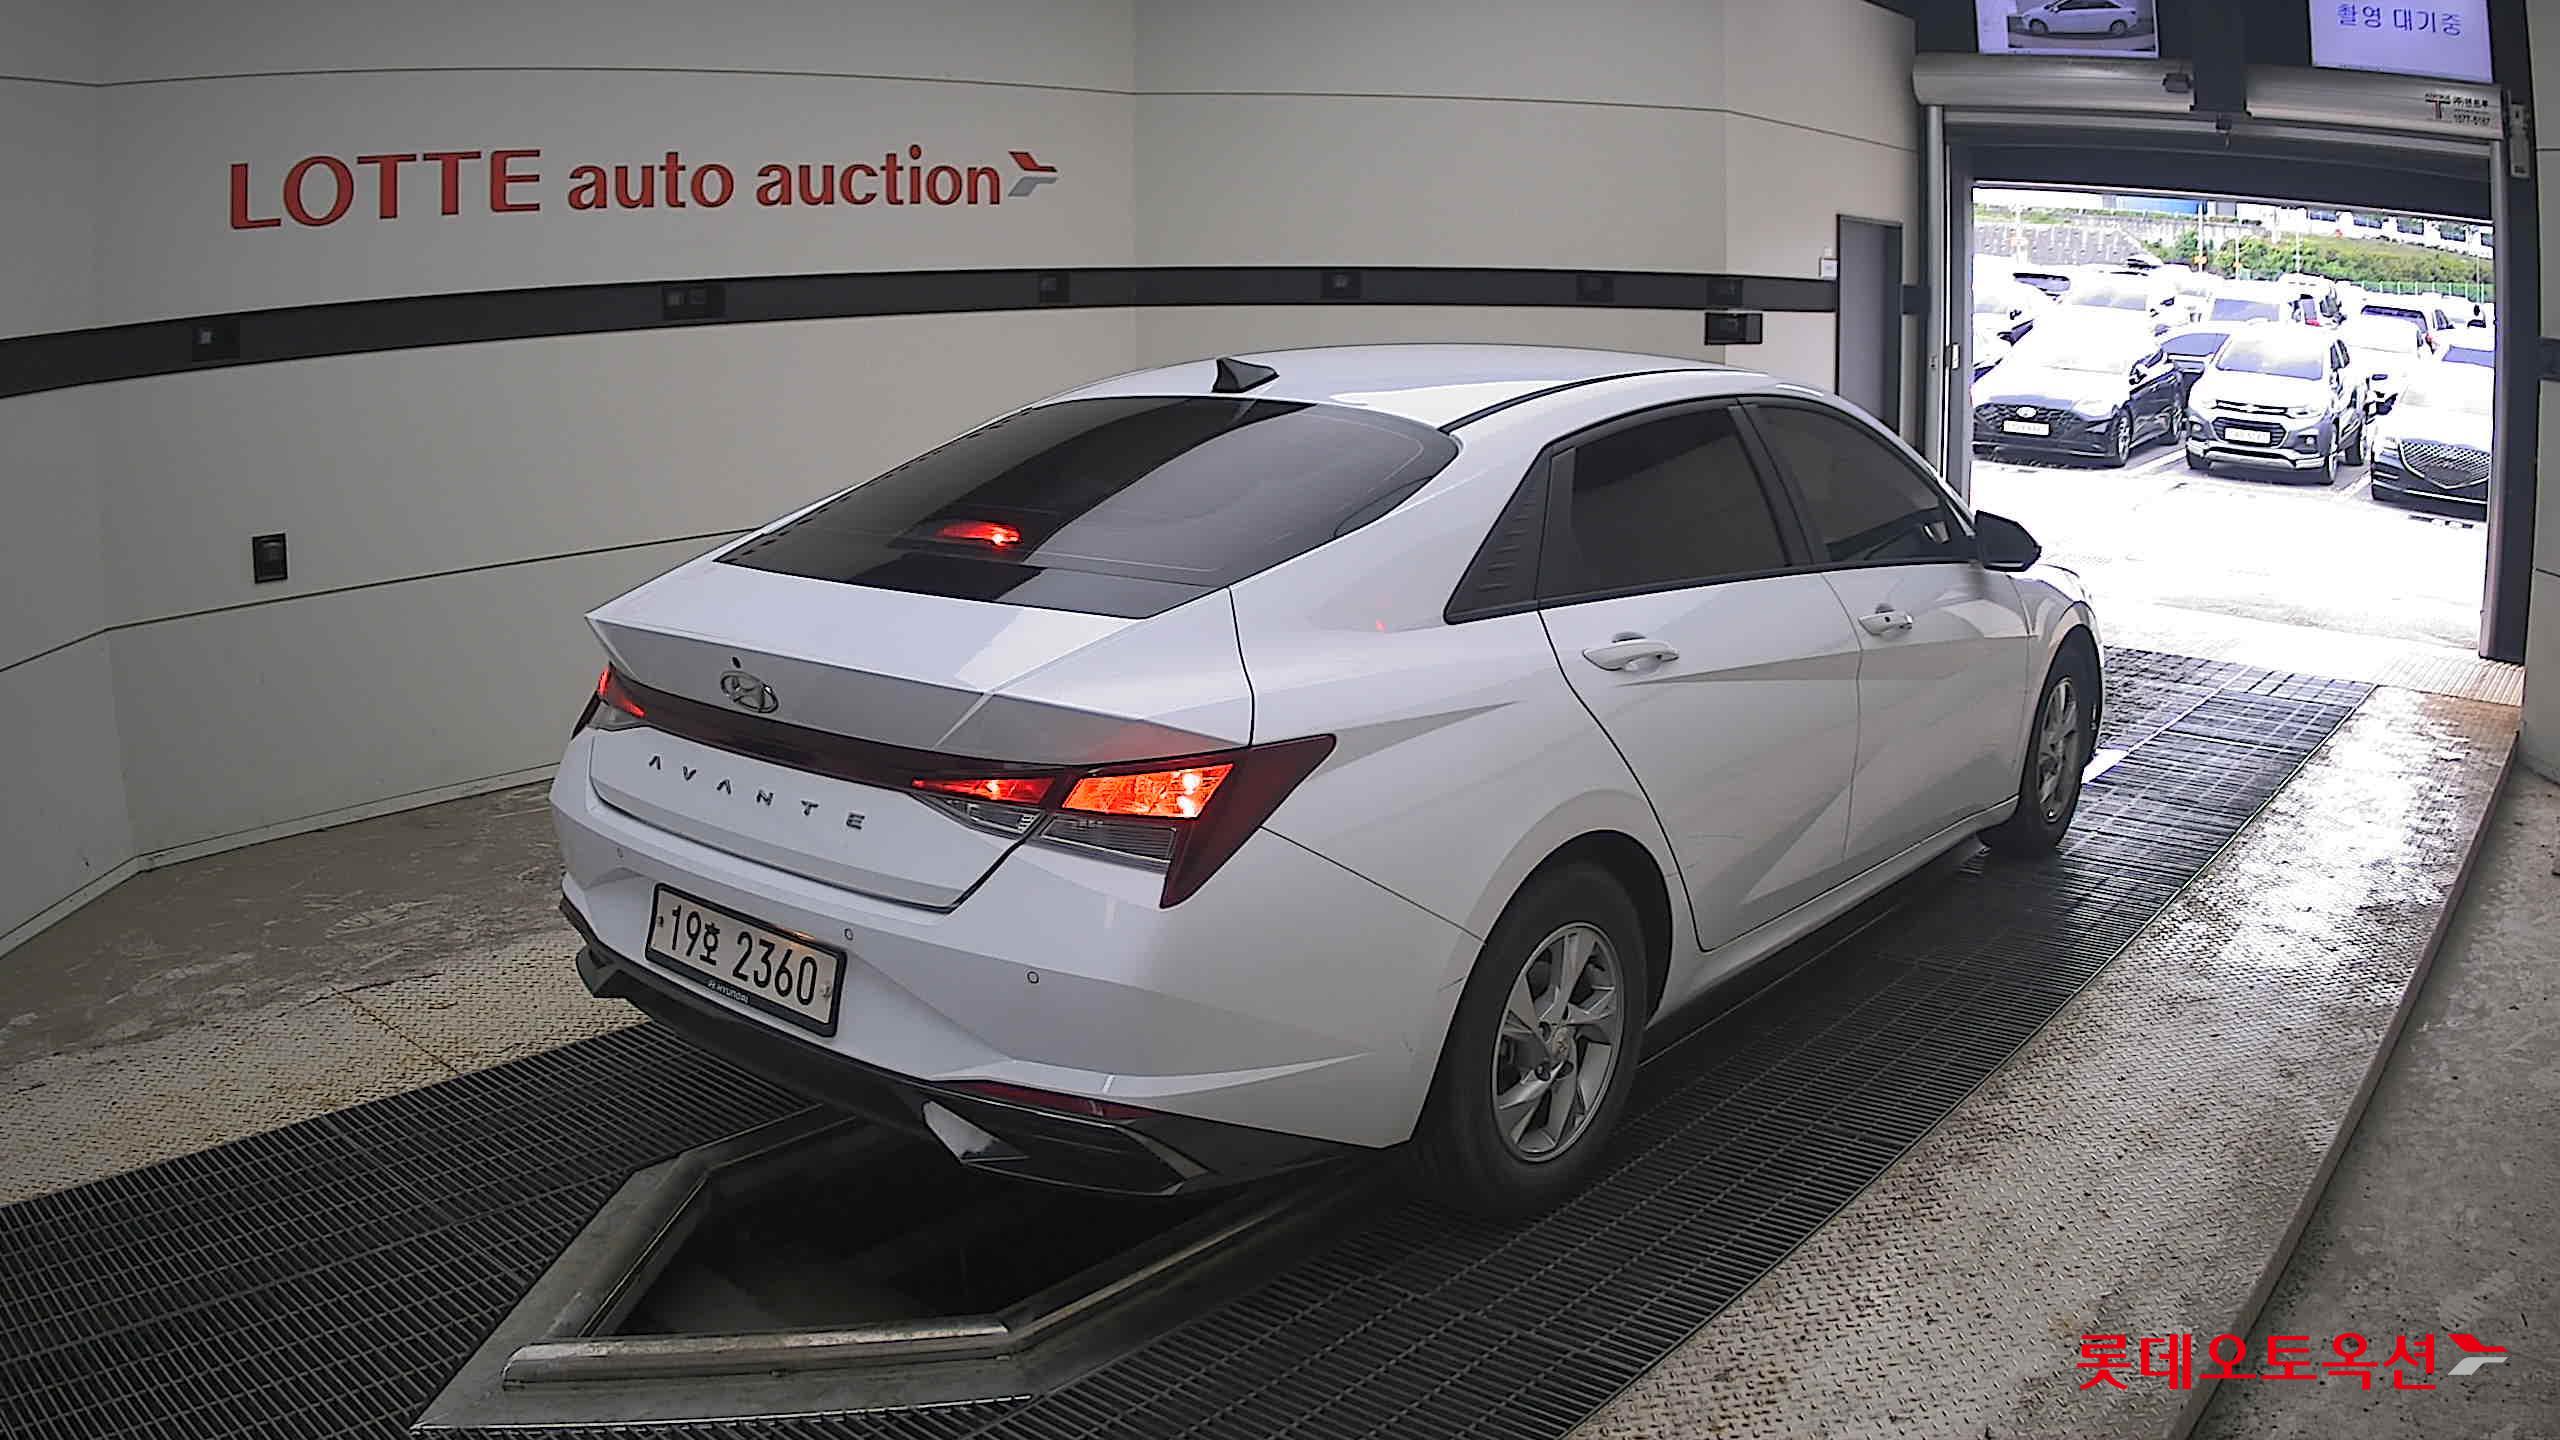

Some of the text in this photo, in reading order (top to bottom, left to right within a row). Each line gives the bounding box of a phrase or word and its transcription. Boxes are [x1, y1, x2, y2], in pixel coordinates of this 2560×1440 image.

[2337, 3, 2461, 36] 촬영 대기중
[231, 144, 1001, 229] LOTTE auto auction
[648, 755, 865, 830] AVANTE
[671, 904, 818, 1006] 19호 2360
